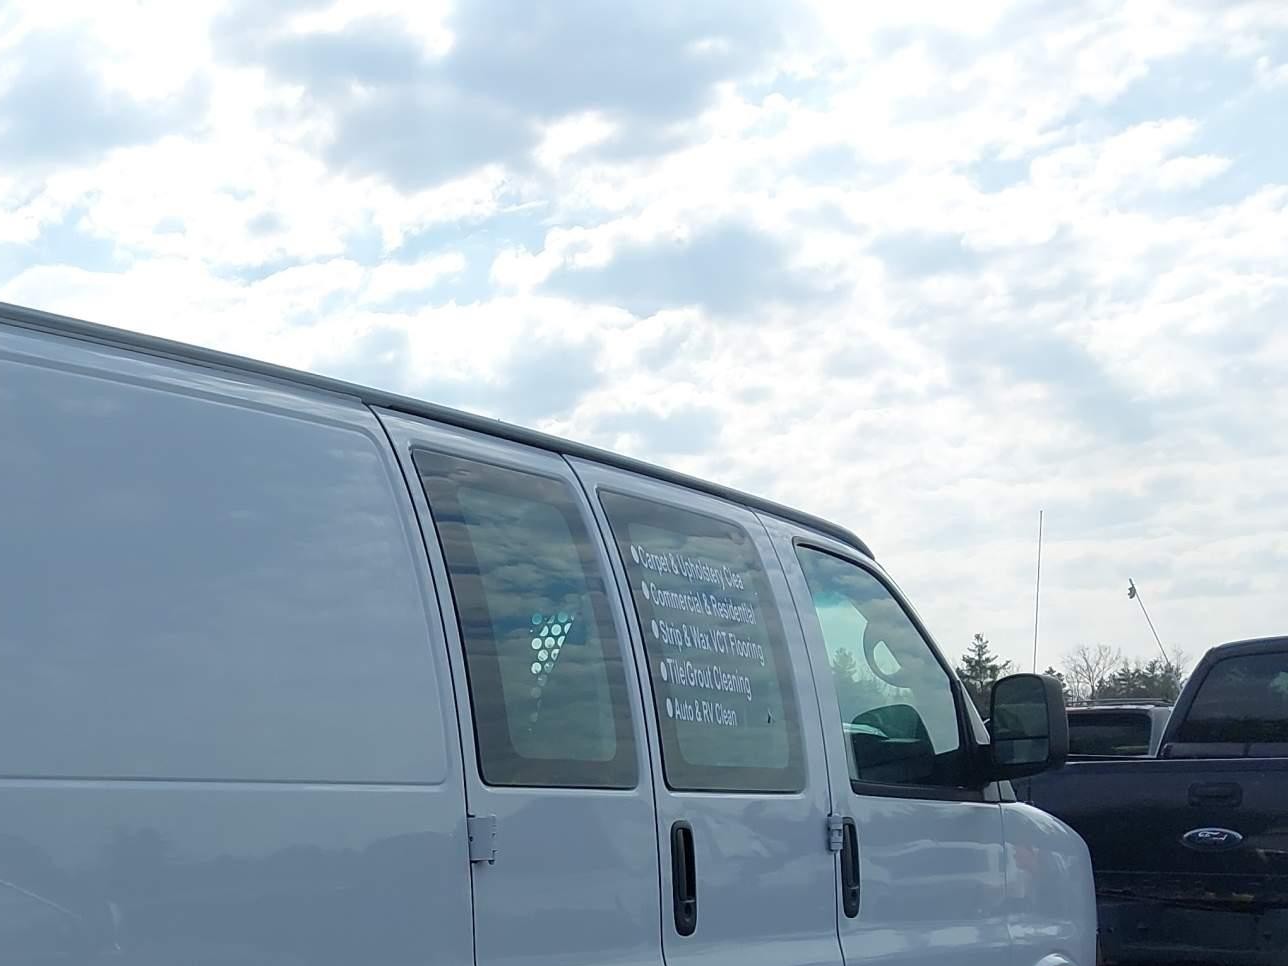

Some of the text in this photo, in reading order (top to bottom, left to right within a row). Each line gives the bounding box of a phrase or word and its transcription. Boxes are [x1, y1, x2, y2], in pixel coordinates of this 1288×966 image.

[638, 545, 668, 577] Carpet
[668, 555, 679, 575] &
[680, 554, 724, 591] Upholstery
[650, 583, 757, 625] Commercial & Residential
[659, 620, 765, 666] Strip & Wax VCT Flooring
[666, 658, 752, 701] Tile/Grout Cleaning
[674, 702, 693, 721] Auto
[695, 700, 702, 722] &
[702, 701, 713, 723] RV
